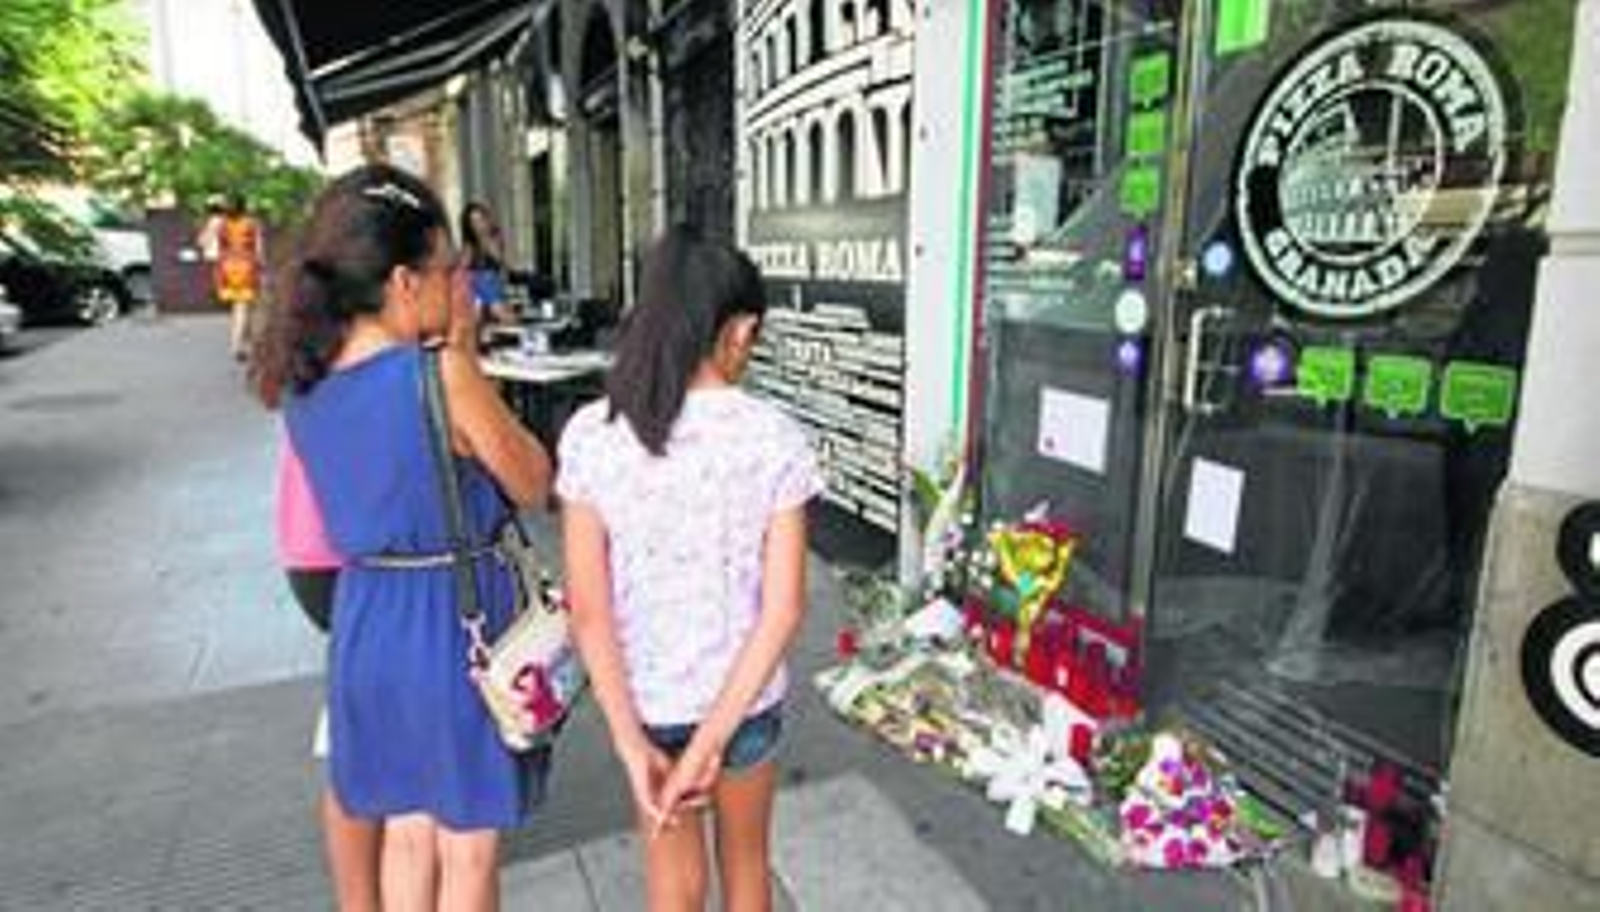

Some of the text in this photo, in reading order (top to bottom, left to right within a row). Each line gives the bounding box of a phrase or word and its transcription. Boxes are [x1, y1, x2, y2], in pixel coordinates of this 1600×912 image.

[1258, 45, 1488, 166] PIZZA ROMA
[816, 236, 902, 281] ROMA
[1263, 229, 1438, 299] GRANADA
